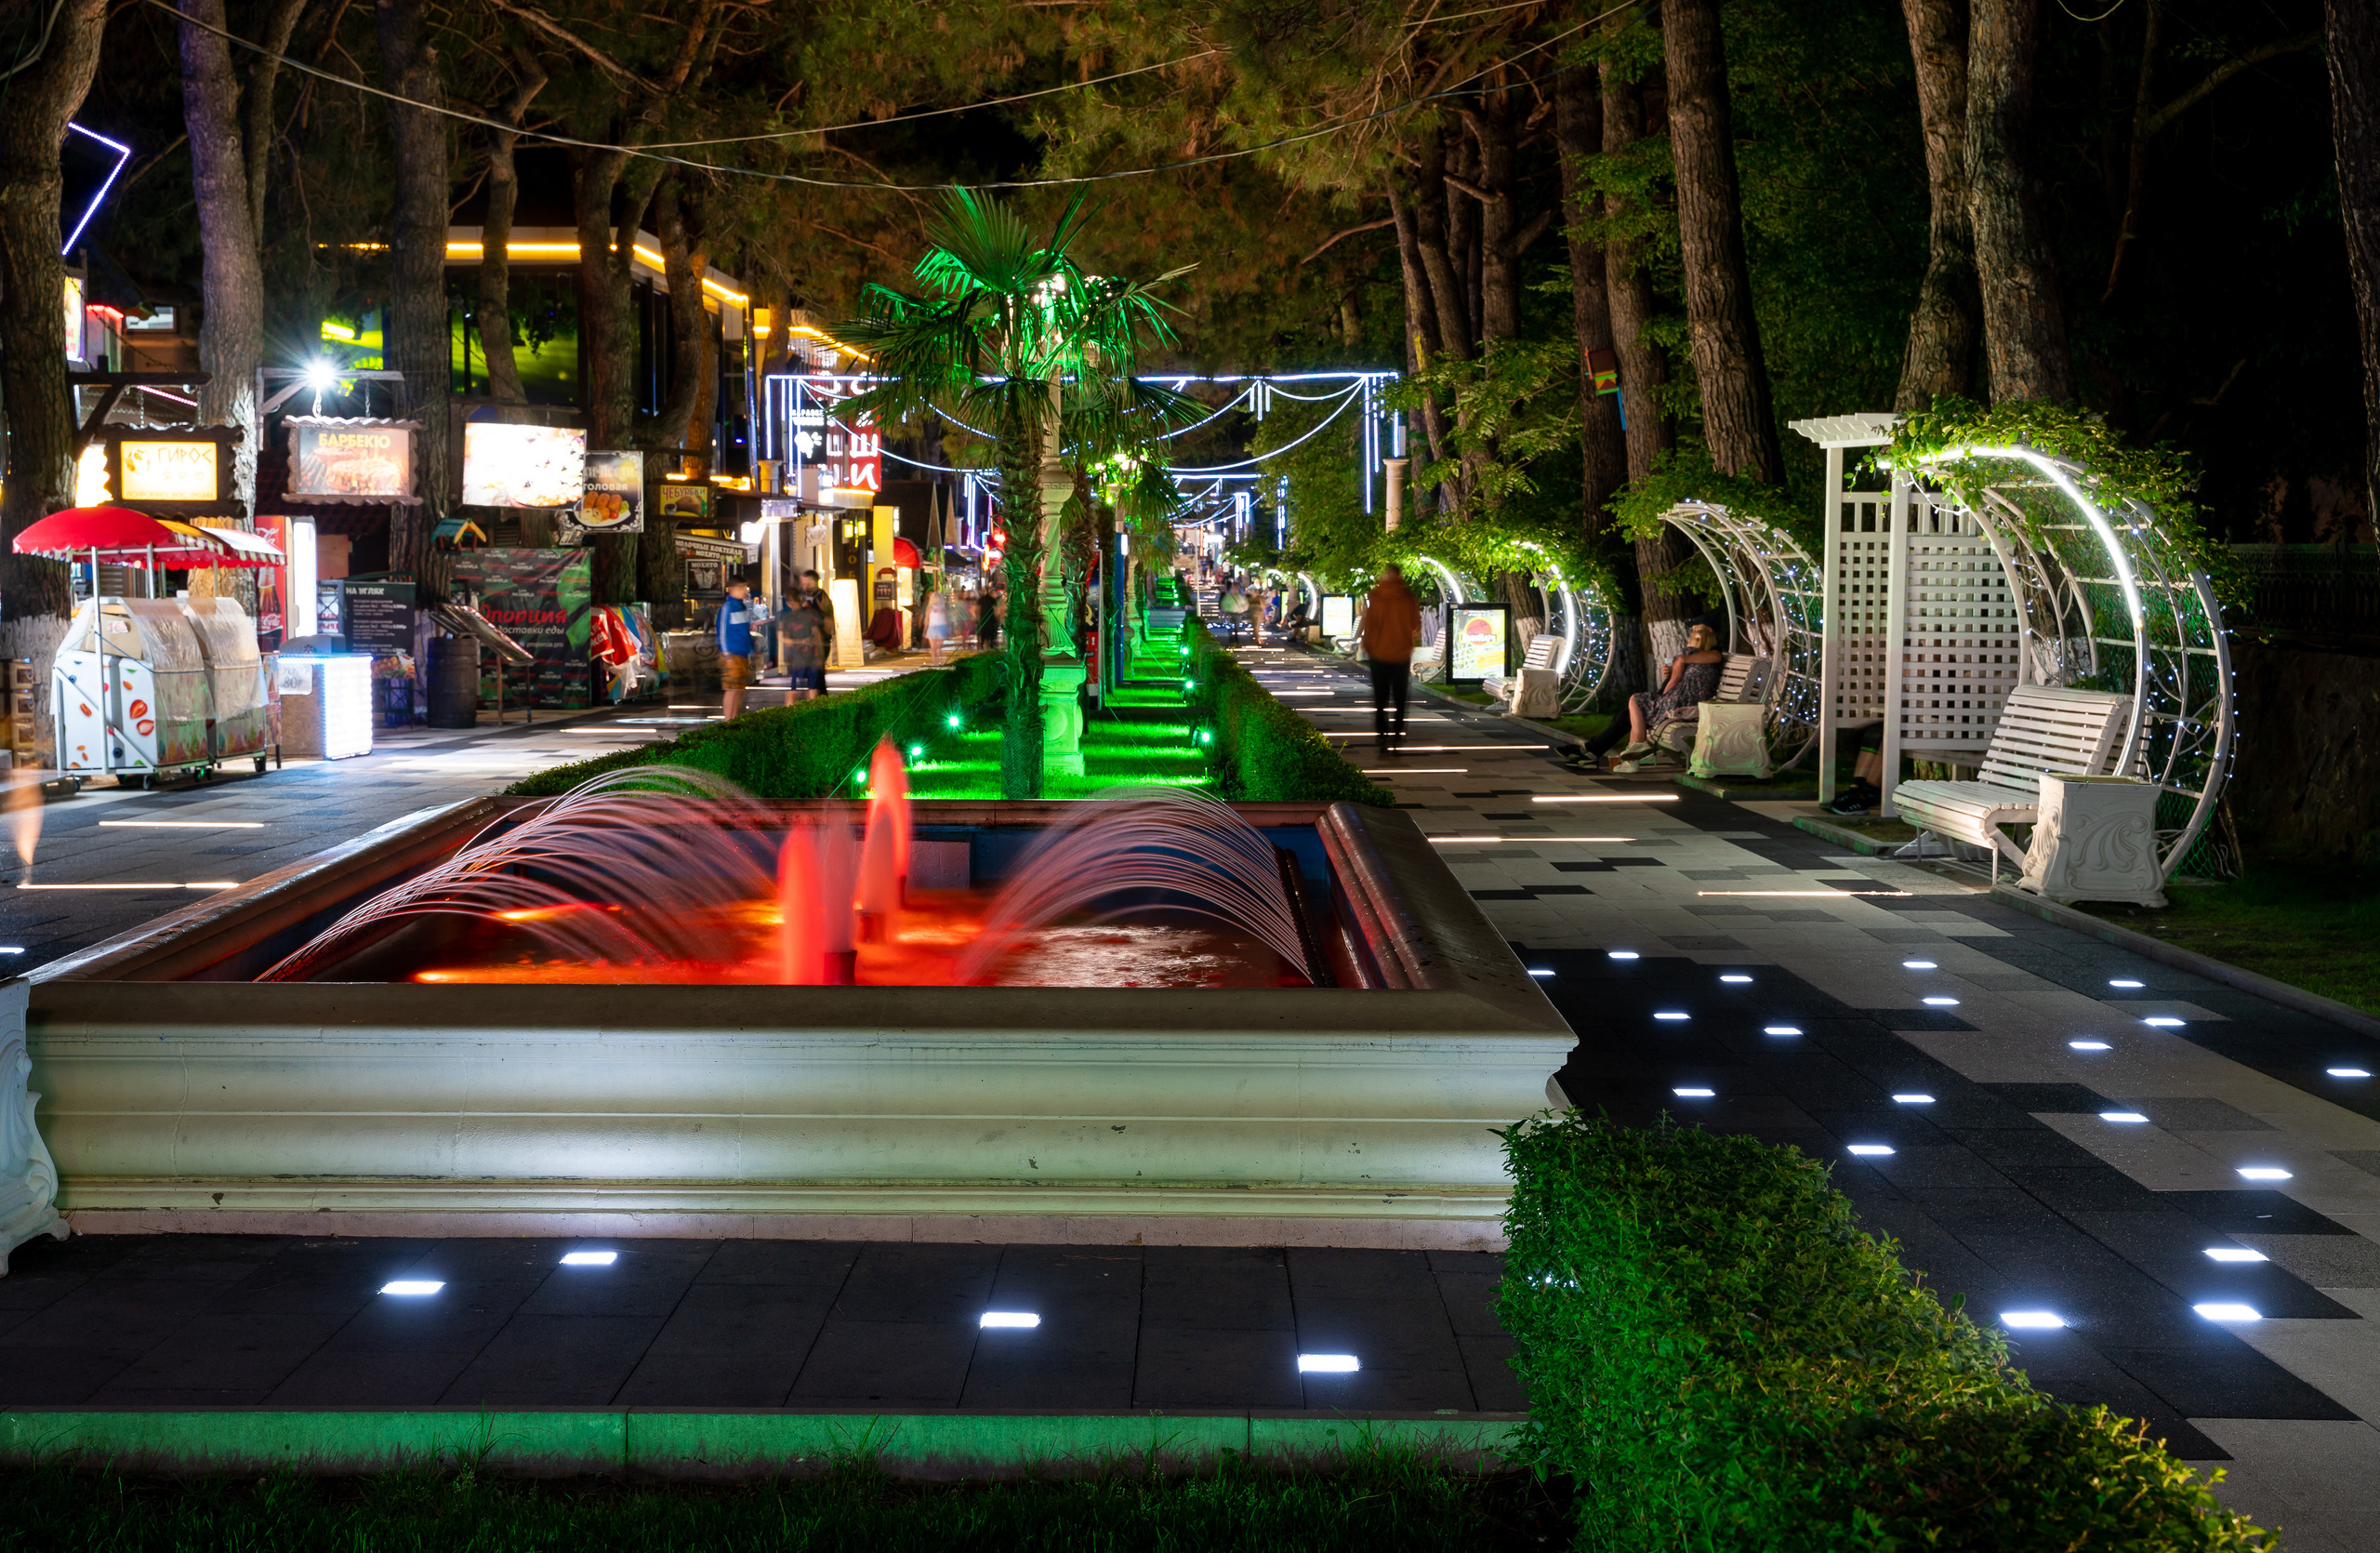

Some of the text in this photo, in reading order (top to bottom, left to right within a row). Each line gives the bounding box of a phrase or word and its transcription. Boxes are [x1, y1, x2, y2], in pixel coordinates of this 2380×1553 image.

[318, 432, 391, 449] БАРБЕКЮ
[157, 446, 213, 464] ГИРОС
[662, 485, 707, 502] ЧЕБУРЕКИ
[545, 625, 565, 635] еды
